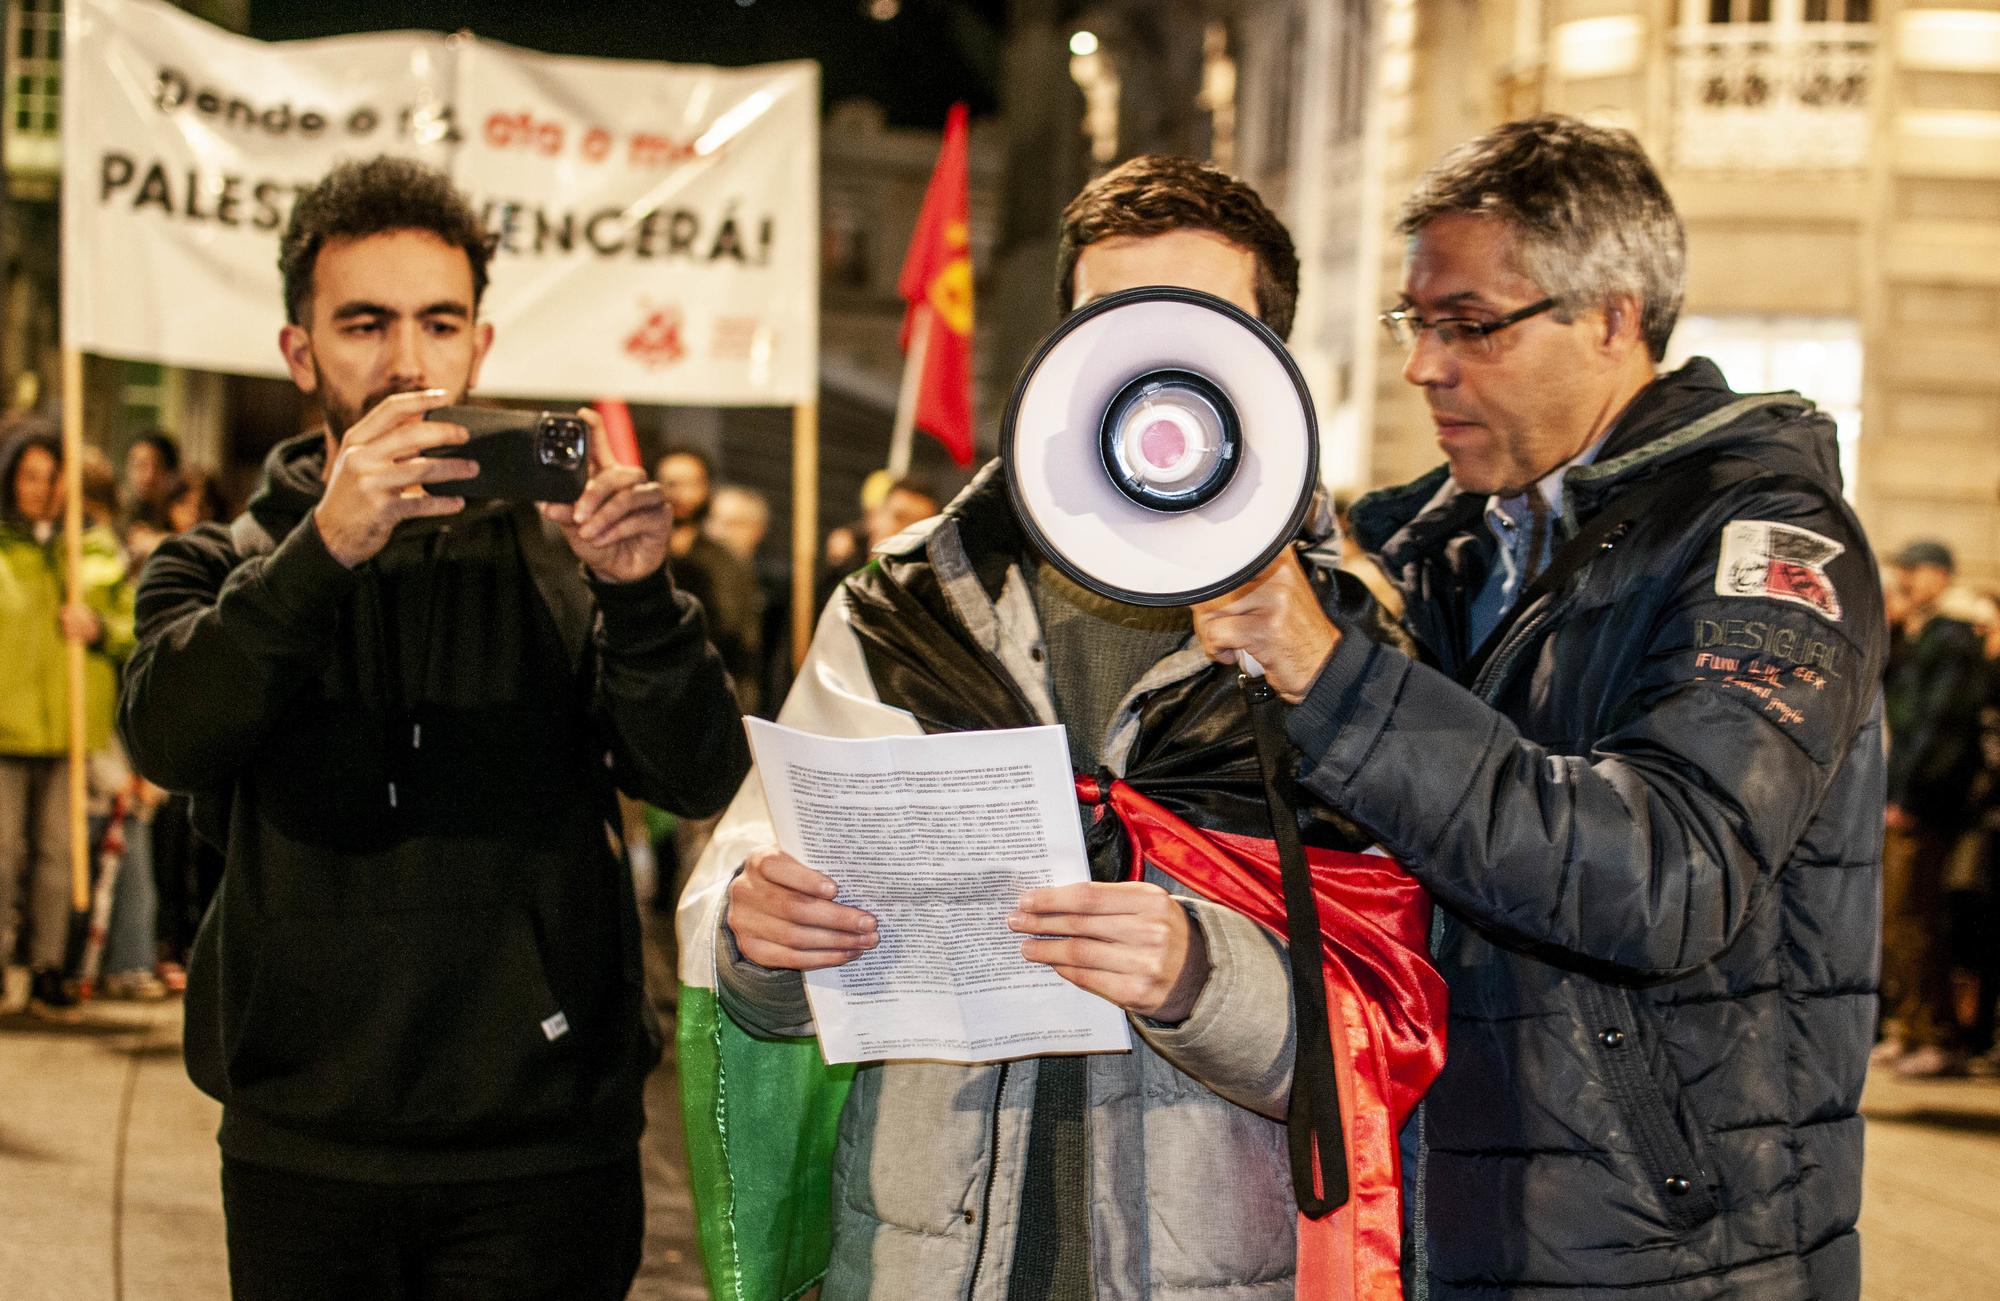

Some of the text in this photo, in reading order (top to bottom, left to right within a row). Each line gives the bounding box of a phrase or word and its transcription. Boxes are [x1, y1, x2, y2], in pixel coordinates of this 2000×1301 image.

[153, 68, 325, 134] Dende
[101, 152, 314, 230] PALEST
[1694, 619, 1842, 678] DESIGUAL
